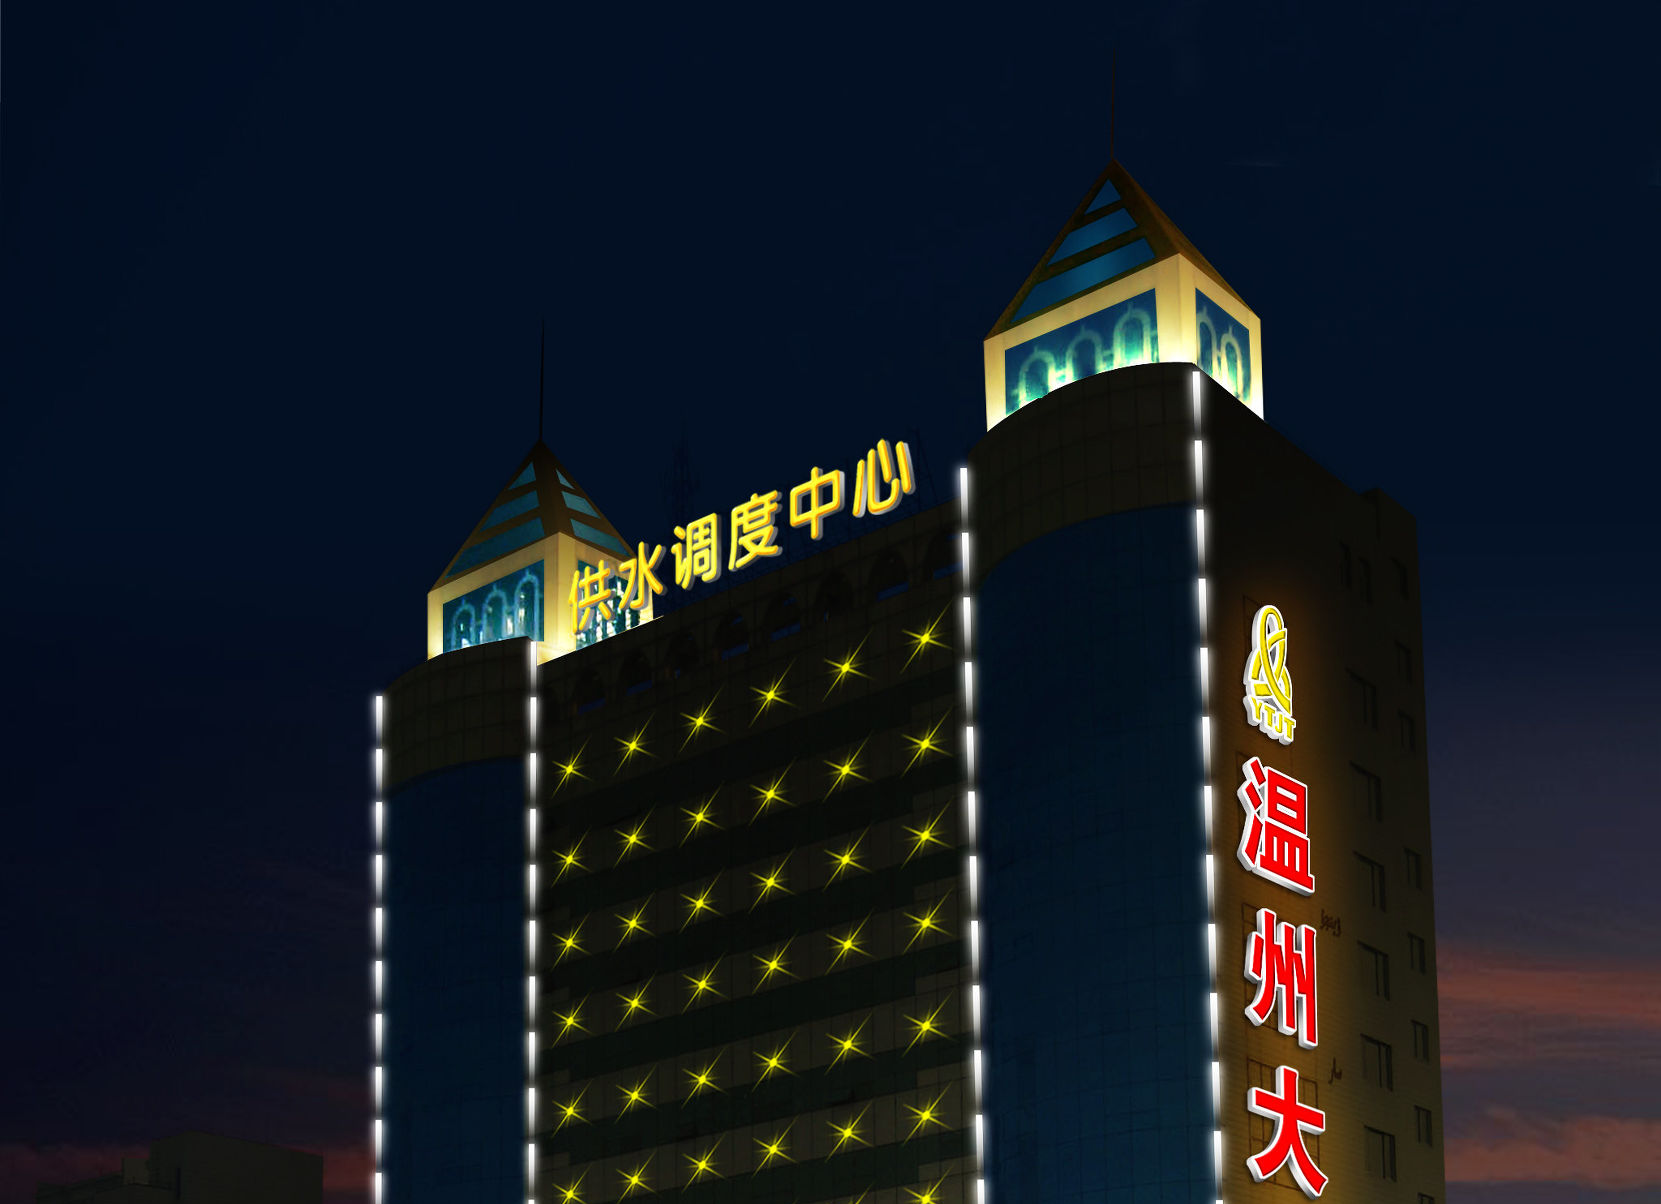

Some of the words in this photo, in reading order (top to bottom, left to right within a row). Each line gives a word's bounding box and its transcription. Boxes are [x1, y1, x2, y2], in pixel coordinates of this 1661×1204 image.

[566, 438, 914, 635] 供水调度中心
[1250, 697, 1296, 741] YTJT
